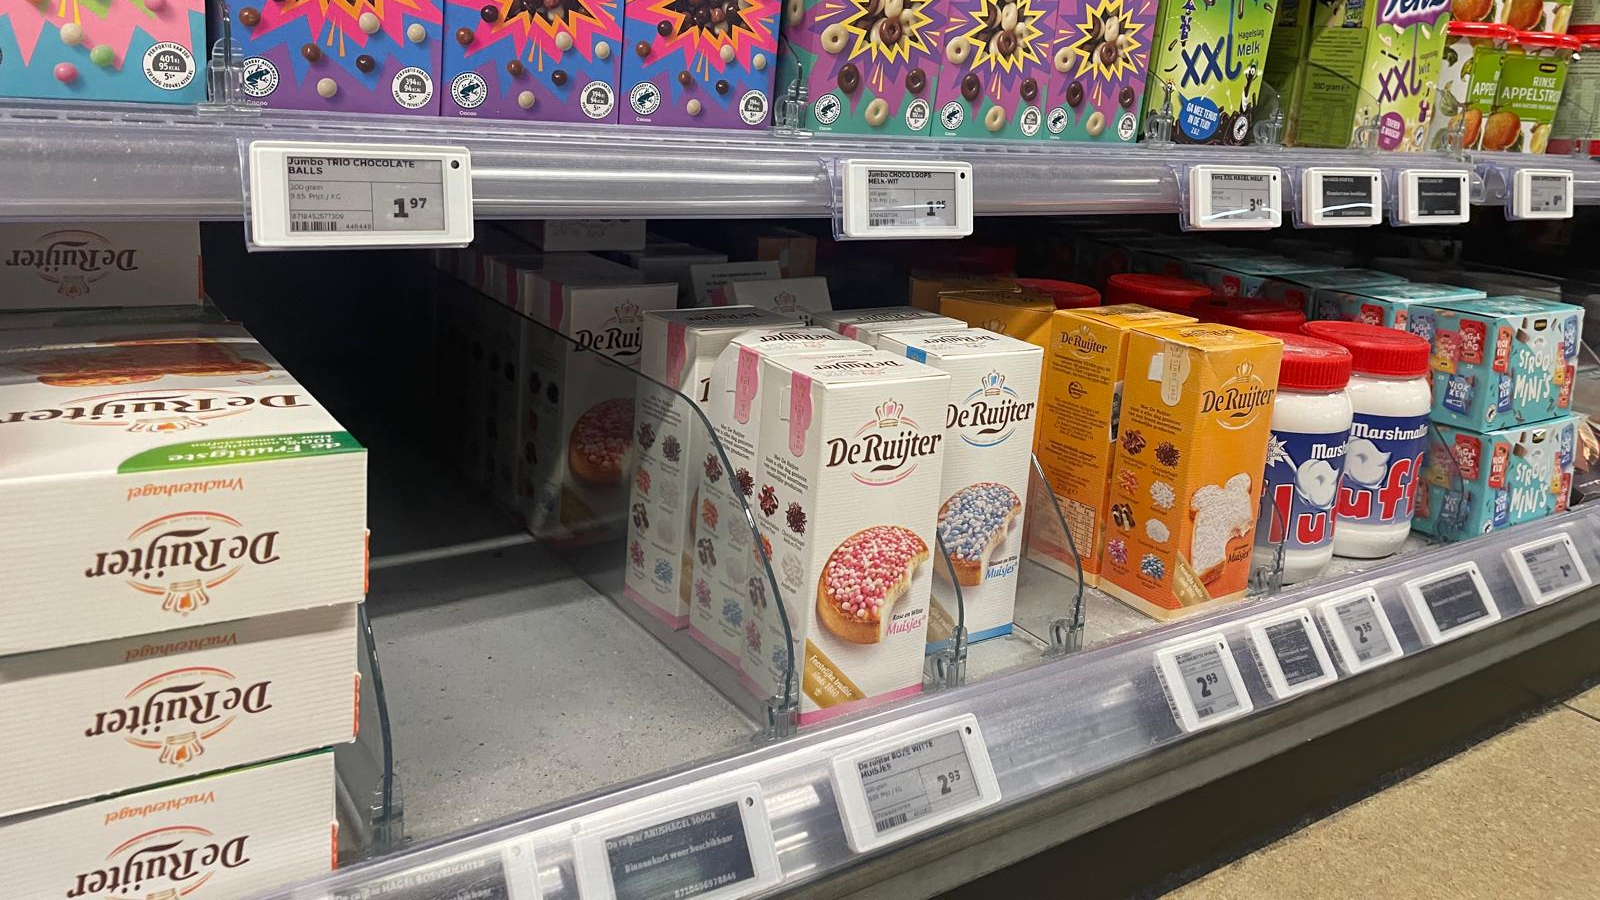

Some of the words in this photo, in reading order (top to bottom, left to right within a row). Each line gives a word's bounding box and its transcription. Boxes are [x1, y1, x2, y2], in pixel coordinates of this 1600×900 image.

[1181, 34, 1242, 88] XXL
[1237, 41, 1260, 57] Melk
[1378, 55, 1422, 103] XXL
[1532, 75, 1557, 88] RINSE
[288, 157, 324, 167] Jumbo
[326, 158, 351, 167] TRIO
[353, 159, 415, 168] CHOCOLATE
[288, 166, 324, 175] BALLS
[5, 240, 102, 273] Ruijter
[102, 248, 140, 272] De
[572, 329, 604, 352] De
[759, 331, 814, 344] Ruijter
[814, 333, 837, 342] De
[923, 333, 976, 345] Ruijter
[1060, 331, 1074, 345] De
[1072, 333, 1108, 354] Ruijter
[813, 360, 876, 372] Ruijter
[875, 359, 904, 369] De
[0, 393, 221, 424] Ruijter
[228, 393, 313, 409] De
[1200, 390, 1224, 414] De
[1224, 385, 1275, 419] Ruijter
[945, 403, 970, 429] De
[970, 398, 1035, 436] Ruijter
[826, 437, 861, 468] De
[861, 430, 942, 473] Ruijter
[127, 477, 246, 501] Vruchtenhagel
[84, 527, 227, 580] Ruijter
[228, 531, 281, 565] De
[985, 563, 1015, 580] Muisjes
[886, 617, 922, 637] Muisjes
[124, 632, 239, 662] Vruchtenhagel
[222, 680, 273, 714] De
[84, 681, 221, 739] Ruijter
[857, 762, 868, 772] De
[891, 747, 911, 760] ROZE
[911, 740, 934, 753] WITTE
[860, 763, 892, 779] MUISJES
[104, 790, 216, 826] Vruchtenhagel
[200, 834, 252, 868] De
[606, 841, 618, 850] De
[624, 852, 670, 873] Binnenkort
[669, 846, 690, 859] weer
[689, 834, 734, 854] beschikbaar
[66, 839, 200, 899] Ruijter
